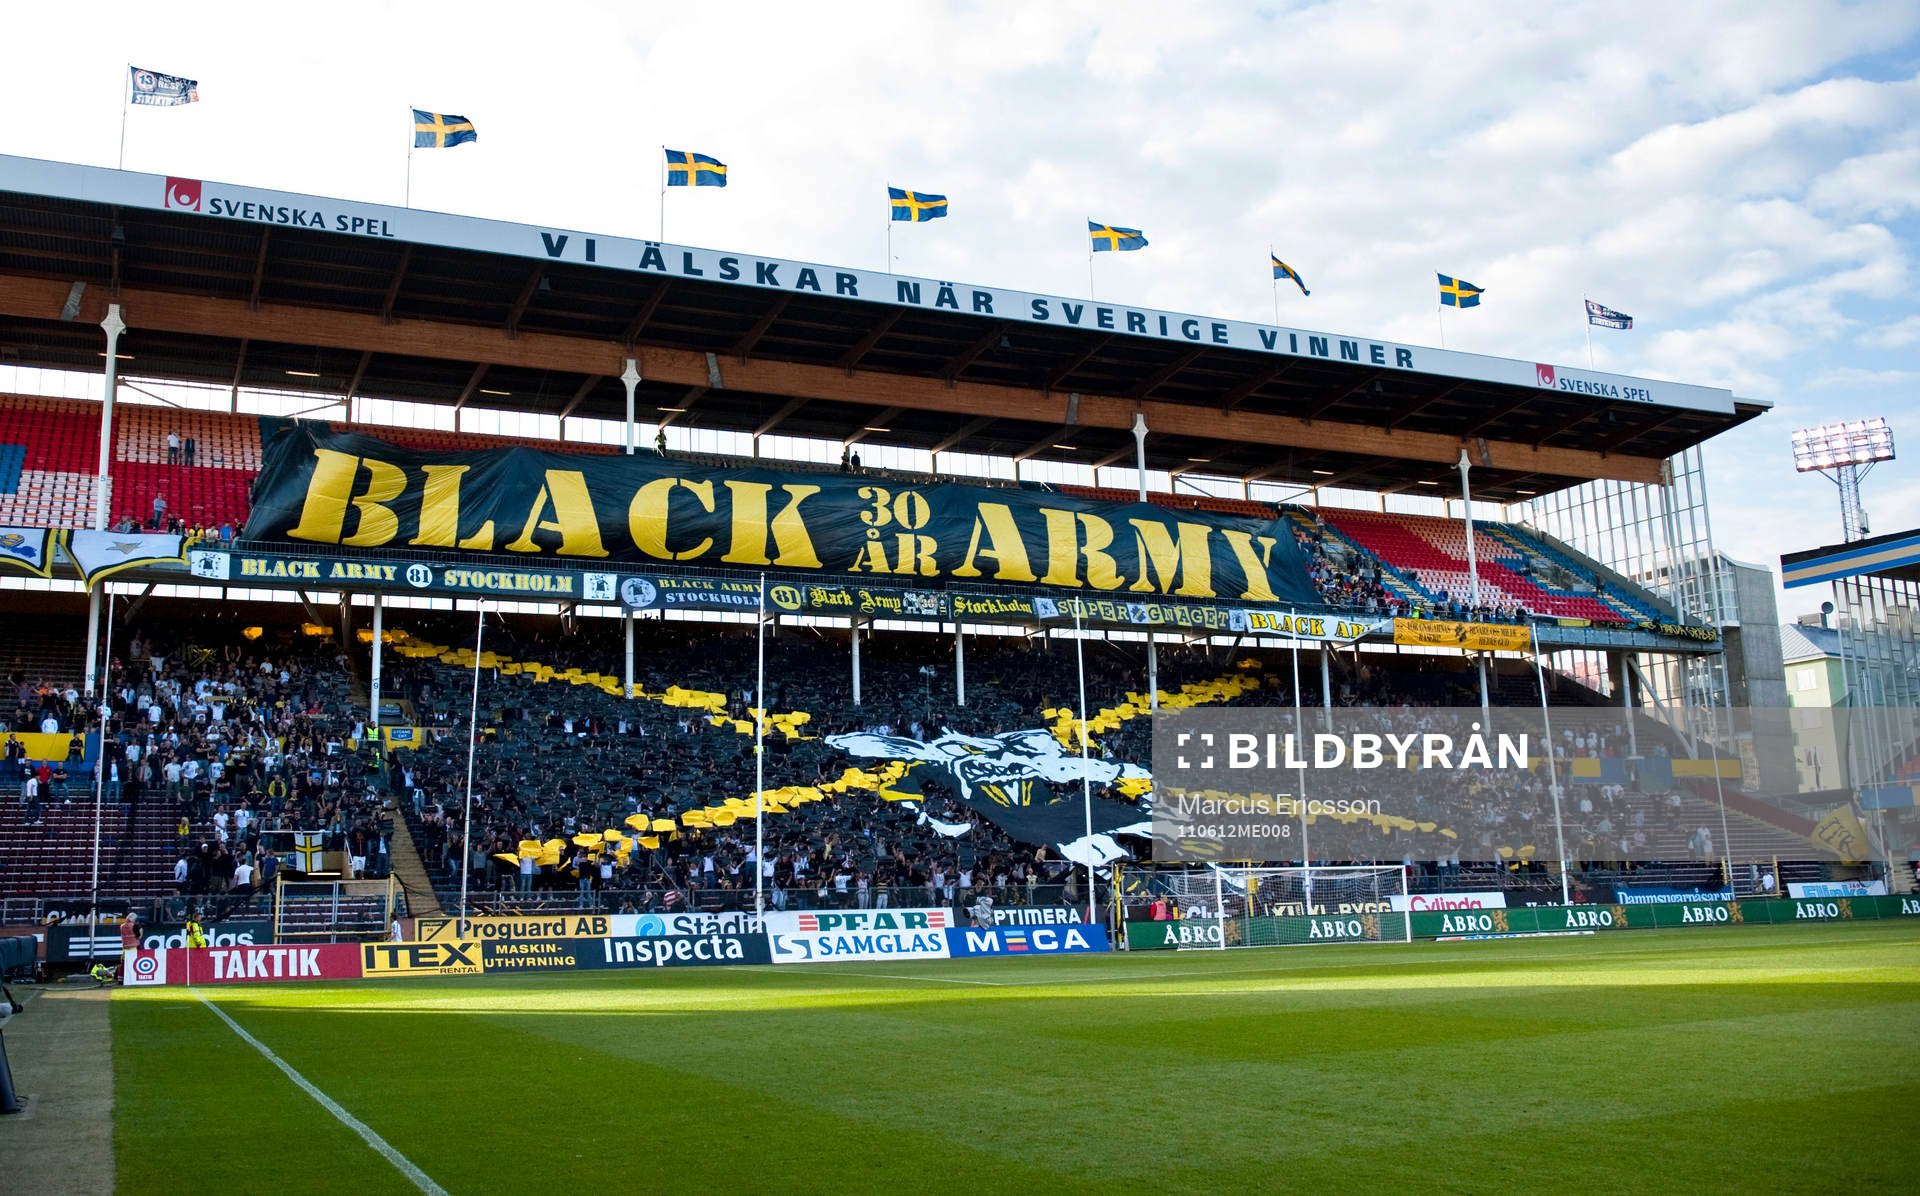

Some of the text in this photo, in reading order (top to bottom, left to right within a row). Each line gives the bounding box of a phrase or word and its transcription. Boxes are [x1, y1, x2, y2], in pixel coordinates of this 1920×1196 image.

[139, 75, 153, 86] 13
[209, 198, 394, 237] SVENSKA SPEL
[540, 233, 1414, 369] VI ÄLSKAR NÄR SVERIGE VINNER
[1560, 377, 1654, 402] SVENSKA SPEL
[857, 486, 931, 530] 30
[287, 448, 1280, 602] BLACK ARMY
[848, 528, 941, 577] ÅR
[241, 558, 574, 593] BLACK ARMY 81 STOCKHOLM
[658, 579, 762, 593] BLACK ARMY
[774, 589, 800, 605] 81
[810, 587, 903, 615] Black Army
[953, 596, 1033, 617] Stockholm
[1057, 601, 1230, 628] SUPER GNAGET
[1249, 613, 1326, 636] BLACK
[1410, 896, 1482, 912] Cylinda
[1682, 906, 1728, 923] ÅBRO
[1796, 902, 1839, 918] ÅBRO
[988, 907, 1081, 926] PTIMERA
[1442, 914, 1492, 933] ÅBRO
[1566, 909, 1612, 927] ÅBRO
[143, 928, 254, 950] addas
[456, 917, 608, 940] Proguard AB
[1163, 924, 1222, 945] ÅBRO
[1309, 919, 1362, 939] ÅBRO
[496, 943, 563, 954] MASKIN-
[604, 935, 744, 966] Inspecta
[818, 933, 942, 956] SAMGLAS
[965, 929, 1091, 952] MECA
[209, 949, 322, 980] TAKTIK
[365, 942, 477, 969] ITEX
[484, 956, 576, 968] UTHYRNING
